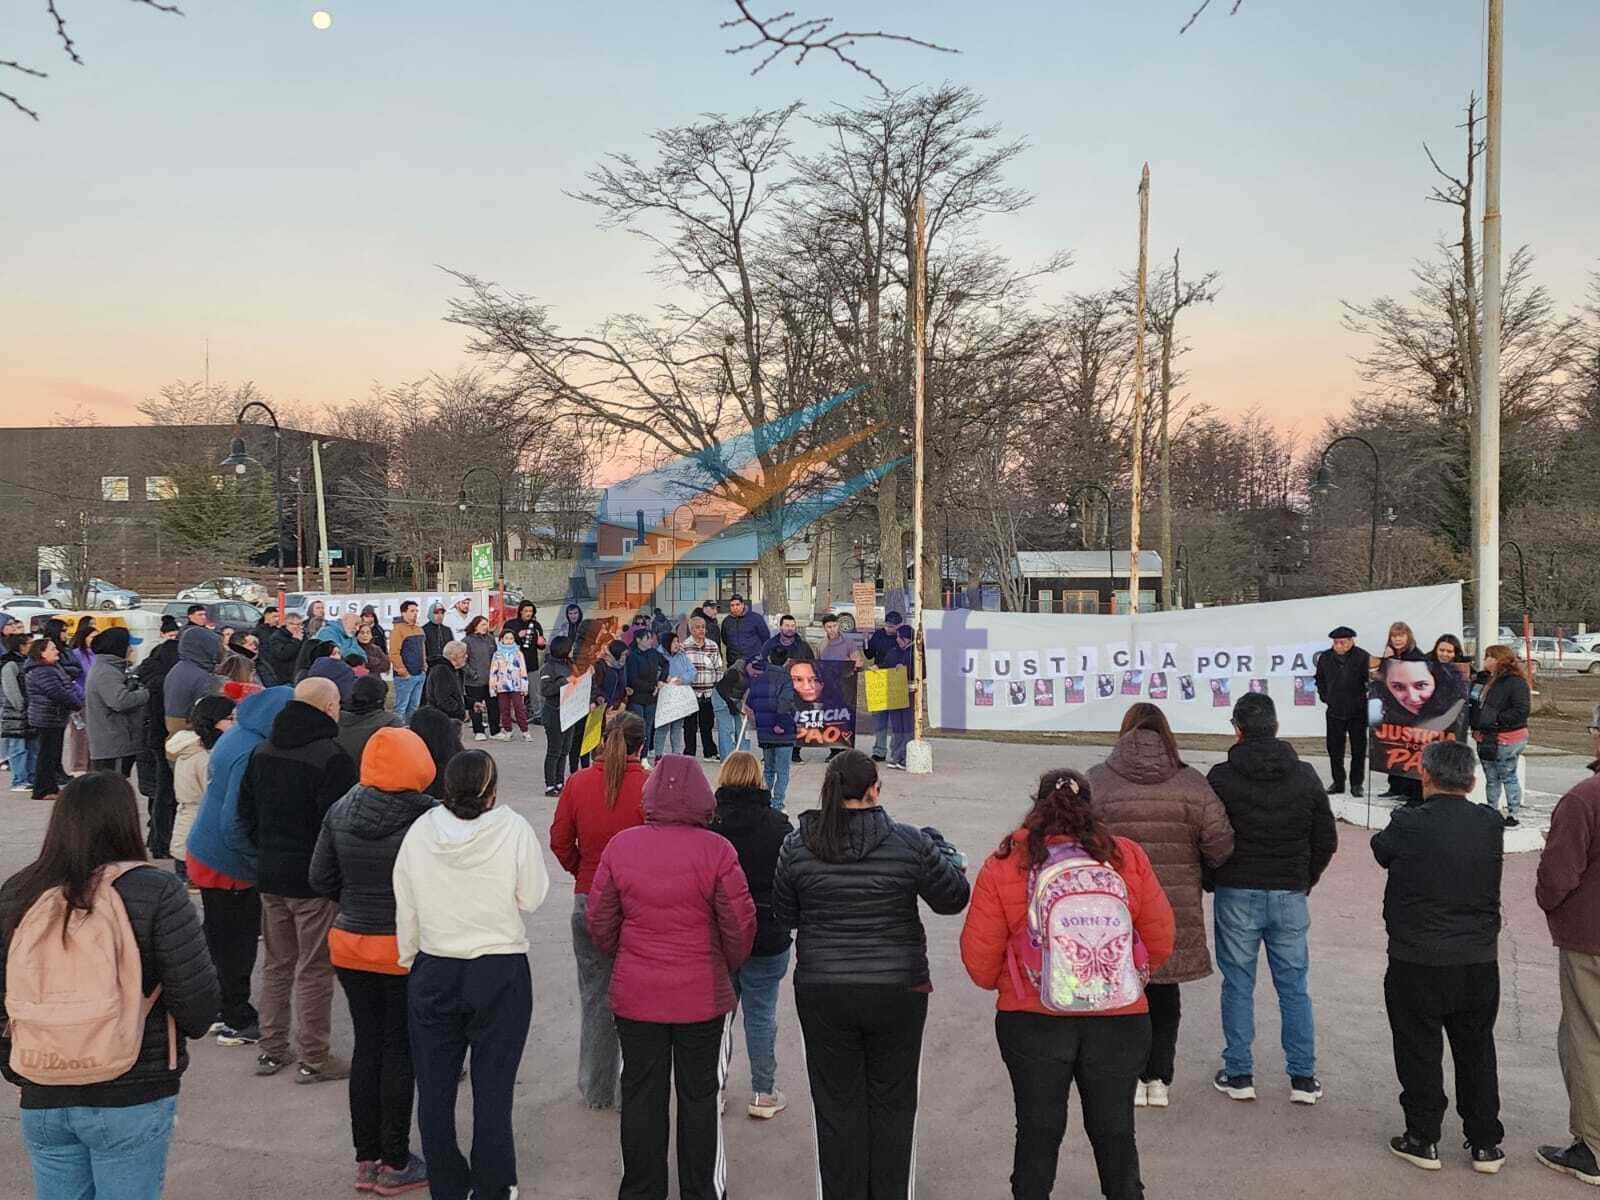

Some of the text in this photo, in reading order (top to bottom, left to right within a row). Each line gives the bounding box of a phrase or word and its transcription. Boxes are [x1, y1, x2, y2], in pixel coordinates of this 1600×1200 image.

[961, 649, 1177, 676] JUSTICIA
[1197, 651, 1252, 674] POR
[805, 720, 824, 728] POR
[1375, 723, 1457, 743] JUSTICIA
[1386, 748, 1425, 775] PA
[20, 1048, 100, 1071] Wilson
